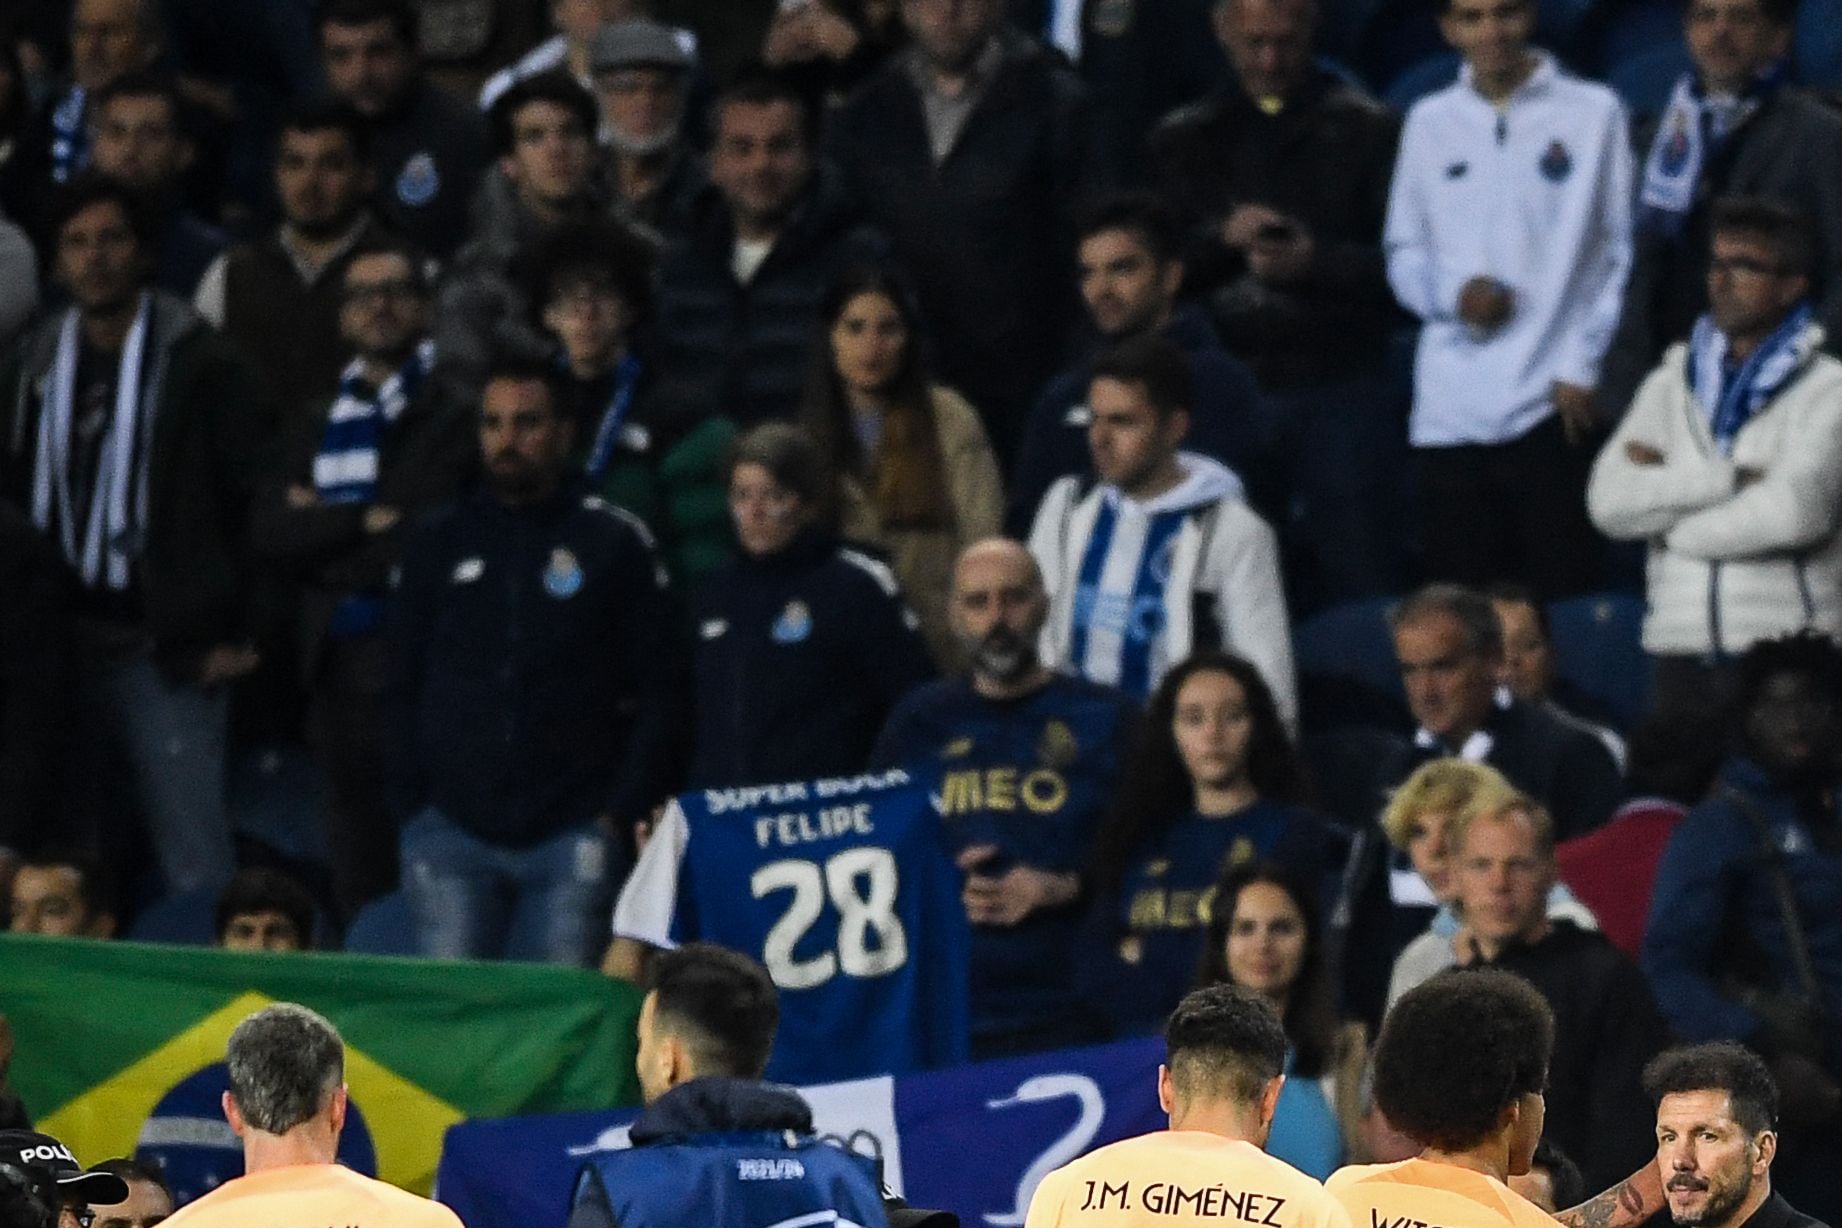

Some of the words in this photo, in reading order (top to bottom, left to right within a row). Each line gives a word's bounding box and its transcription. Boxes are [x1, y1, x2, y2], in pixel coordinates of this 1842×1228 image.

[941, 768, 1068, 815] MEO
[755, 803, 874, 848] FELIPE
[752, 847, 908, 989] 28
[1080, 1180, 1131, 1211] J.M.
[1142, 1183, 1286, 1228] GIMÉNEZ
